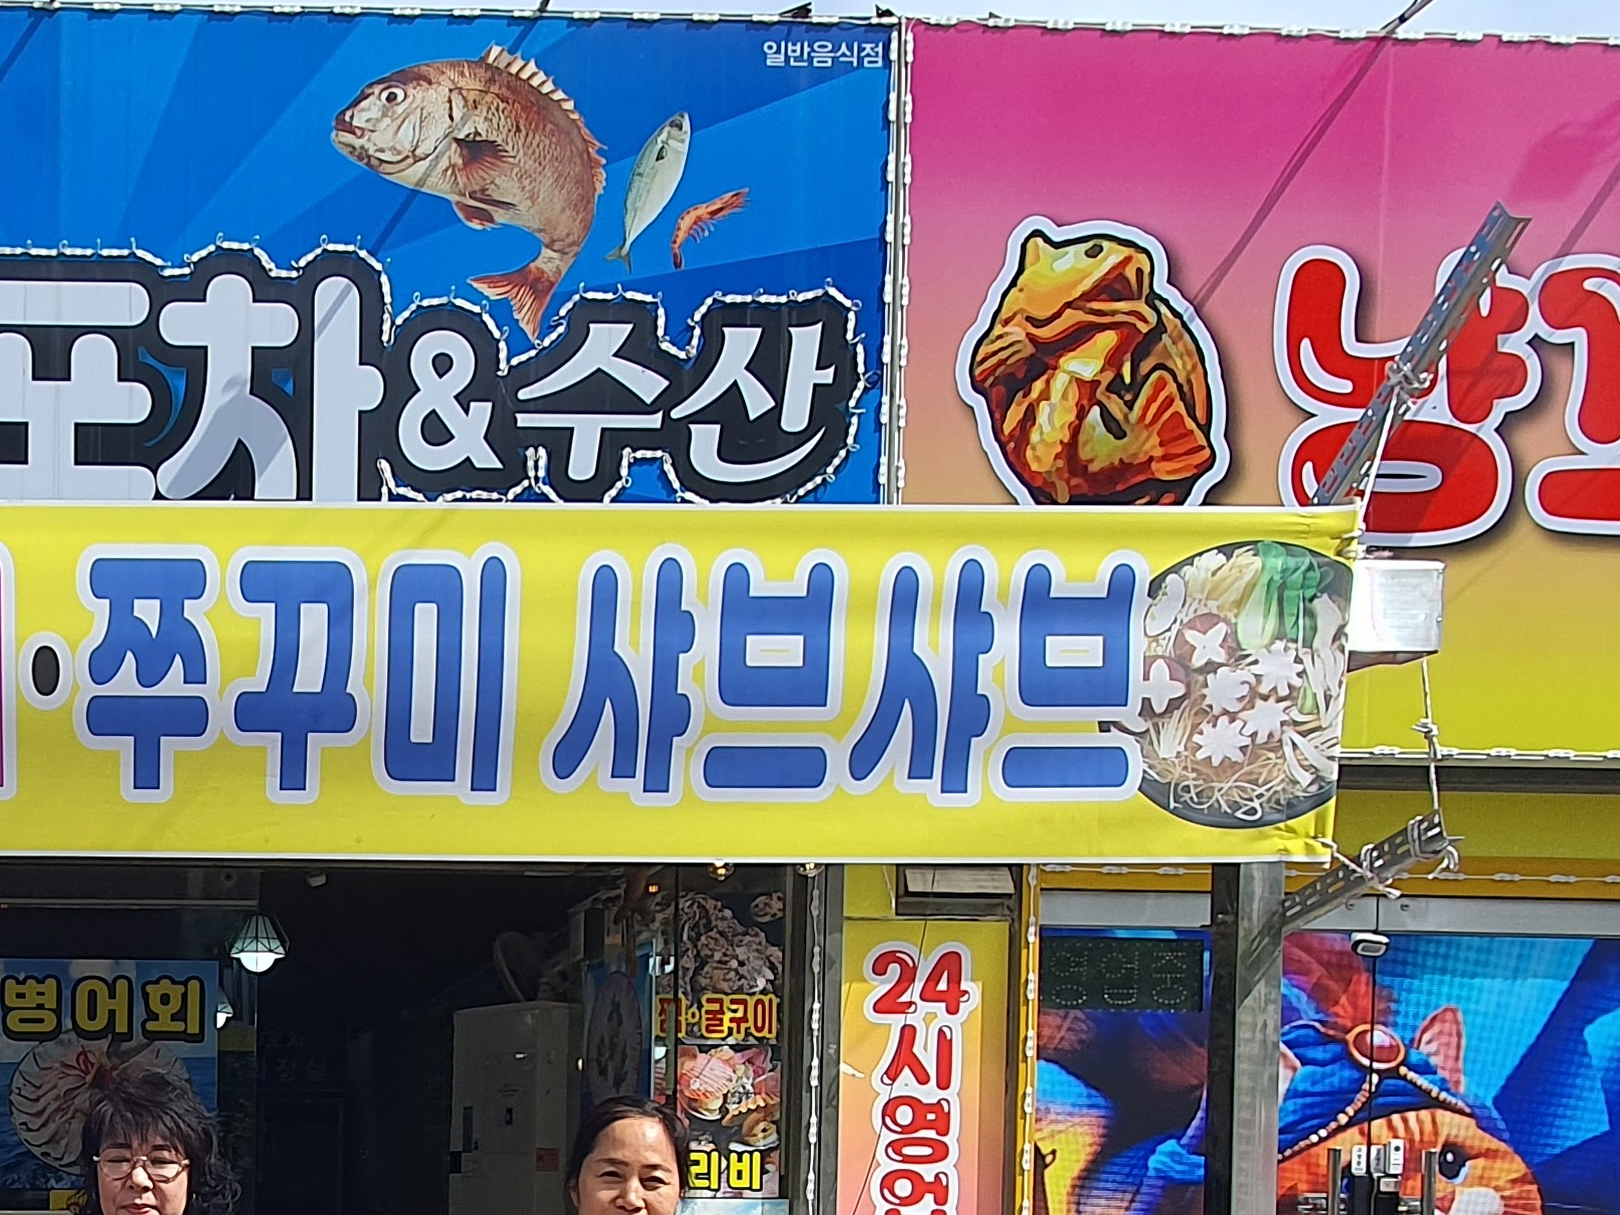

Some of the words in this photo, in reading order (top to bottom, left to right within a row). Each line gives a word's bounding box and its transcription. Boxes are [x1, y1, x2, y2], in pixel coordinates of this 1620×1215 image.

[762, 40, 884, 69] 일반음식점
[550, 556, 1136, 794] 샤브샤브
[1049, 951, 1188, 1005] 영업중
[3, 978, 201, 1034] 병어회
